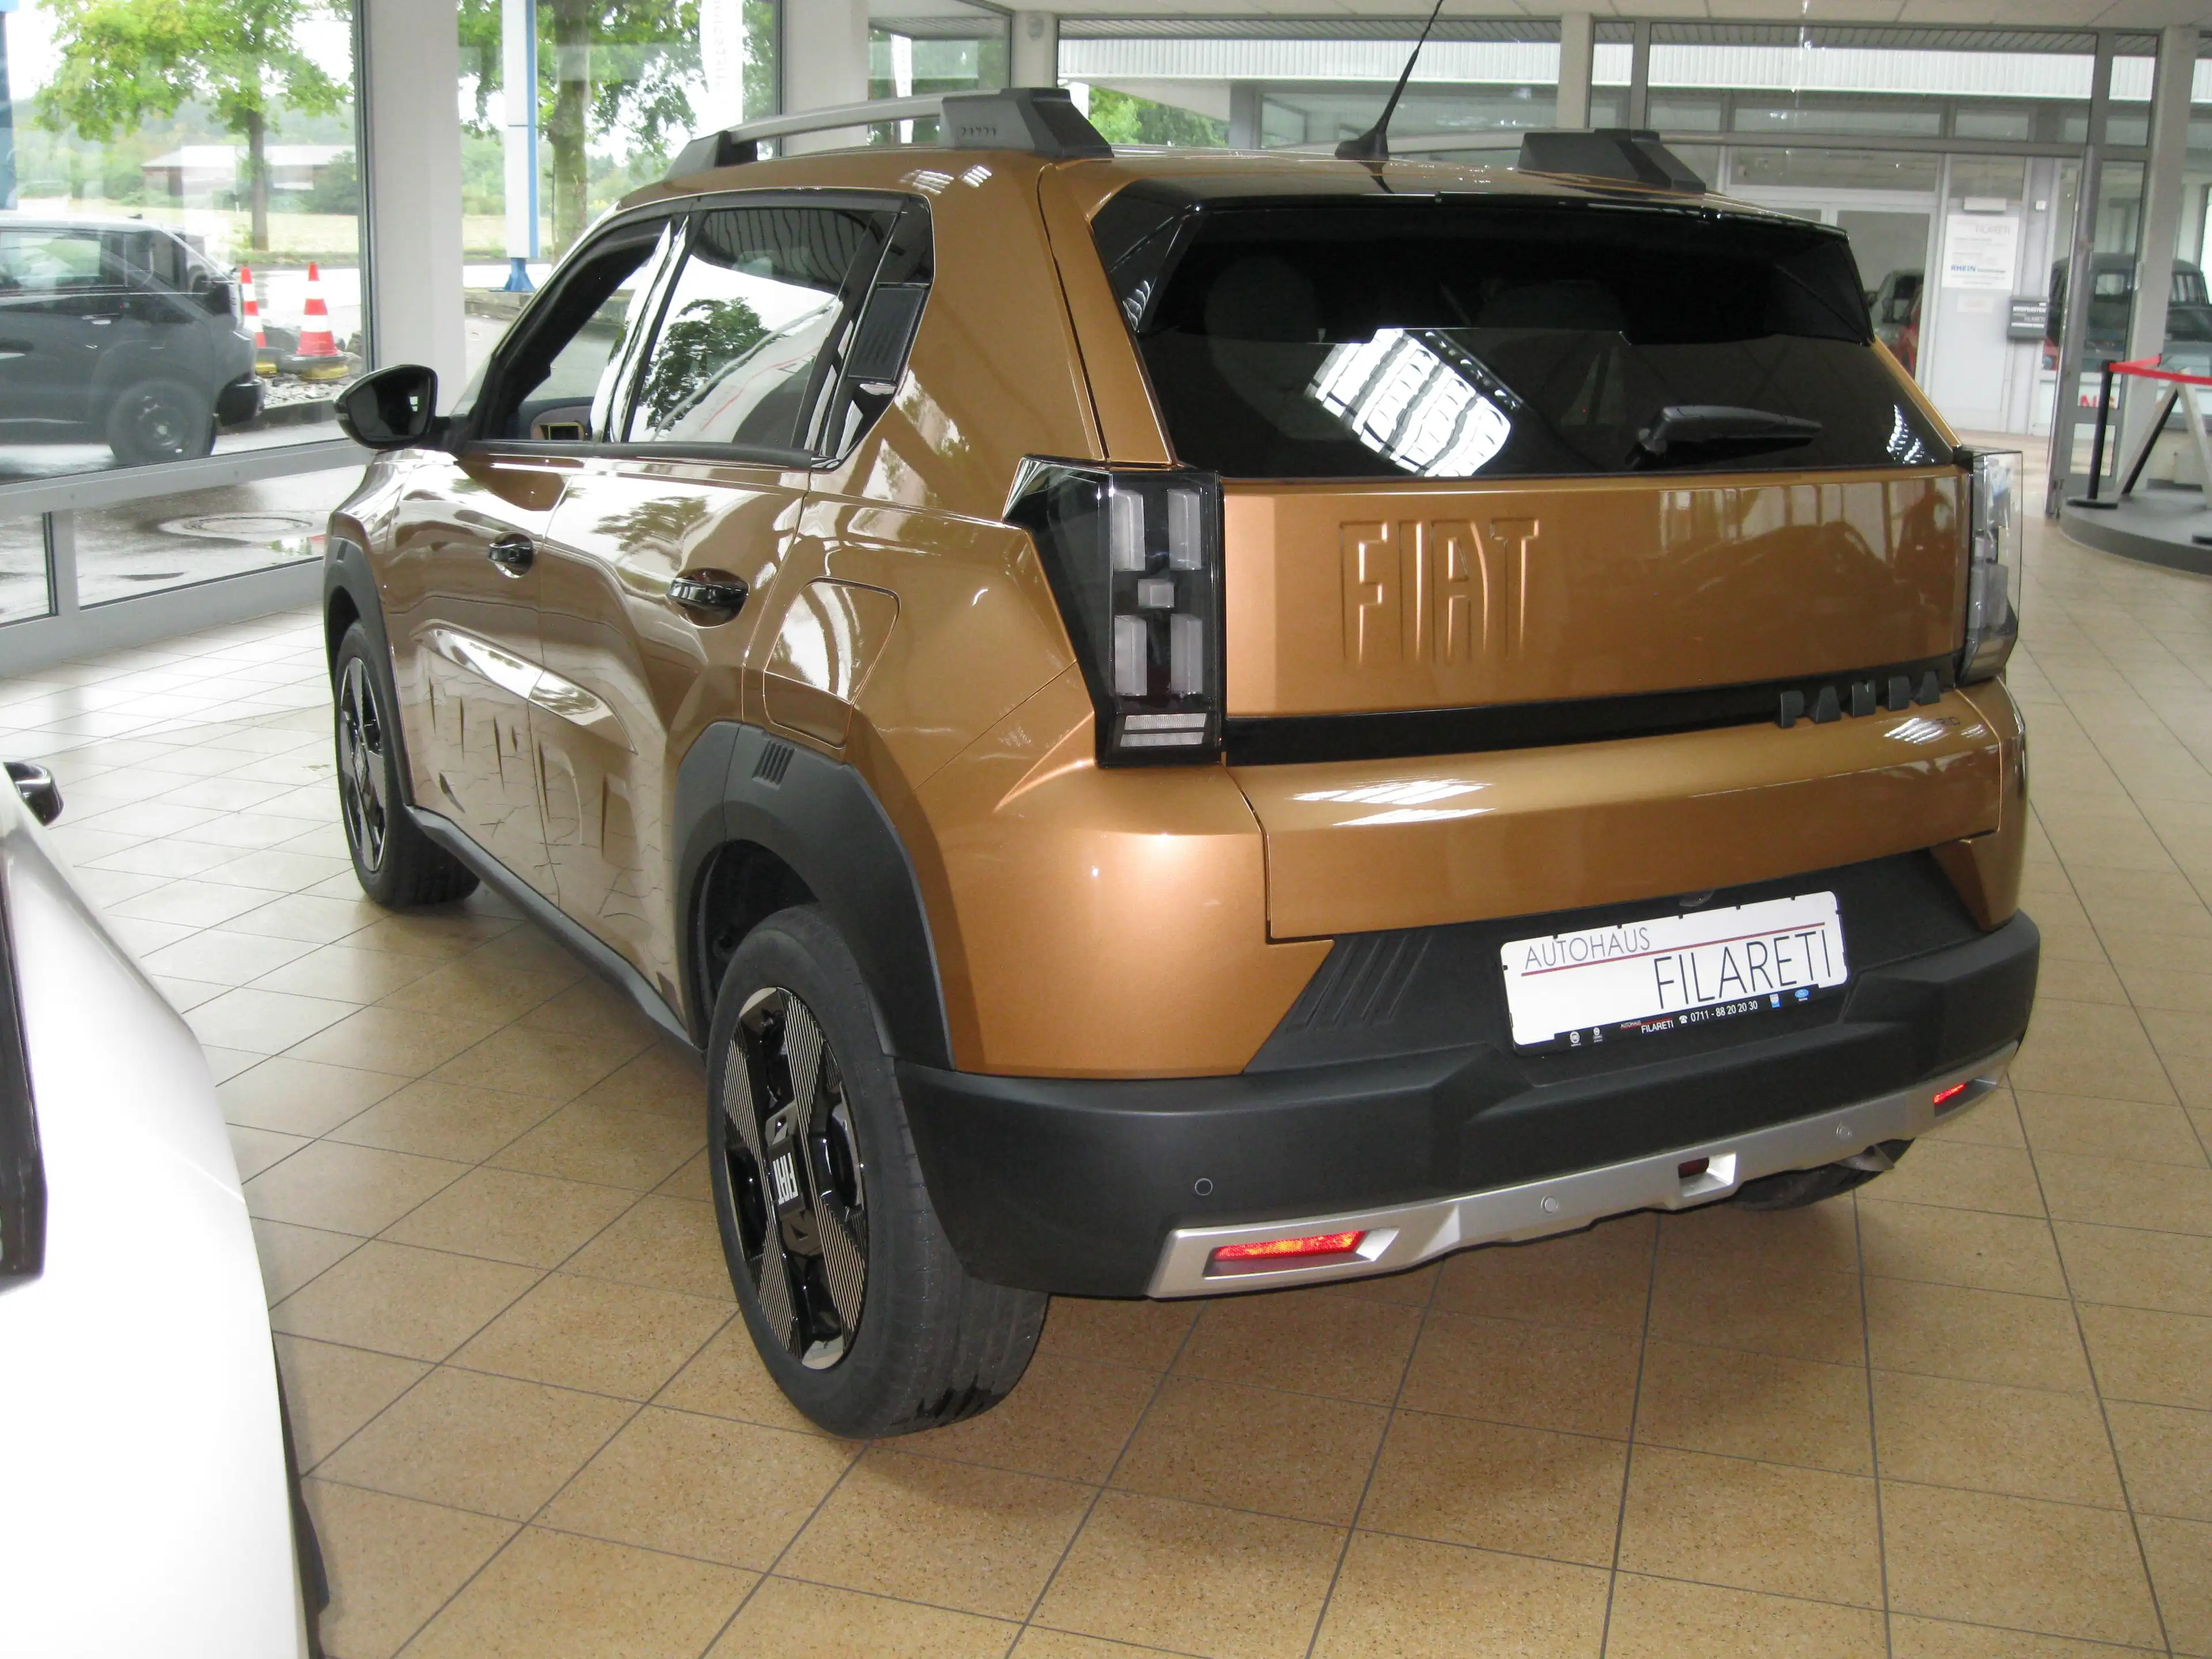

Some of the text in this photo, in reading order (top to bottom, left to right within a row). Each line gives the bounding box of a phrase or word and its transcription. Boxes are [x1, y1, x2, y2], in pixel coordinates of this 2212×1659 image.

[1950, 264, 1976, 272] RHEIN
[1339, 518, 1539, 664] FIAT
[1778, 670, 1941, 728] PANDA
[1525, 927, 1650, 970] AUTOHAUS
[1654, 929, 1831, 1009] FILARETI
[1641, 1020, 1674, 1033] FILARETI
[1690, 1010, 1709, 1022] 0711
[1715, 1006, 1726, 1017] 88
[1726, 1005, 1737, 1014] 20
[1738, 1002, 1748, 1013] 20
[1748, 1000, 1758, 1011] 30
